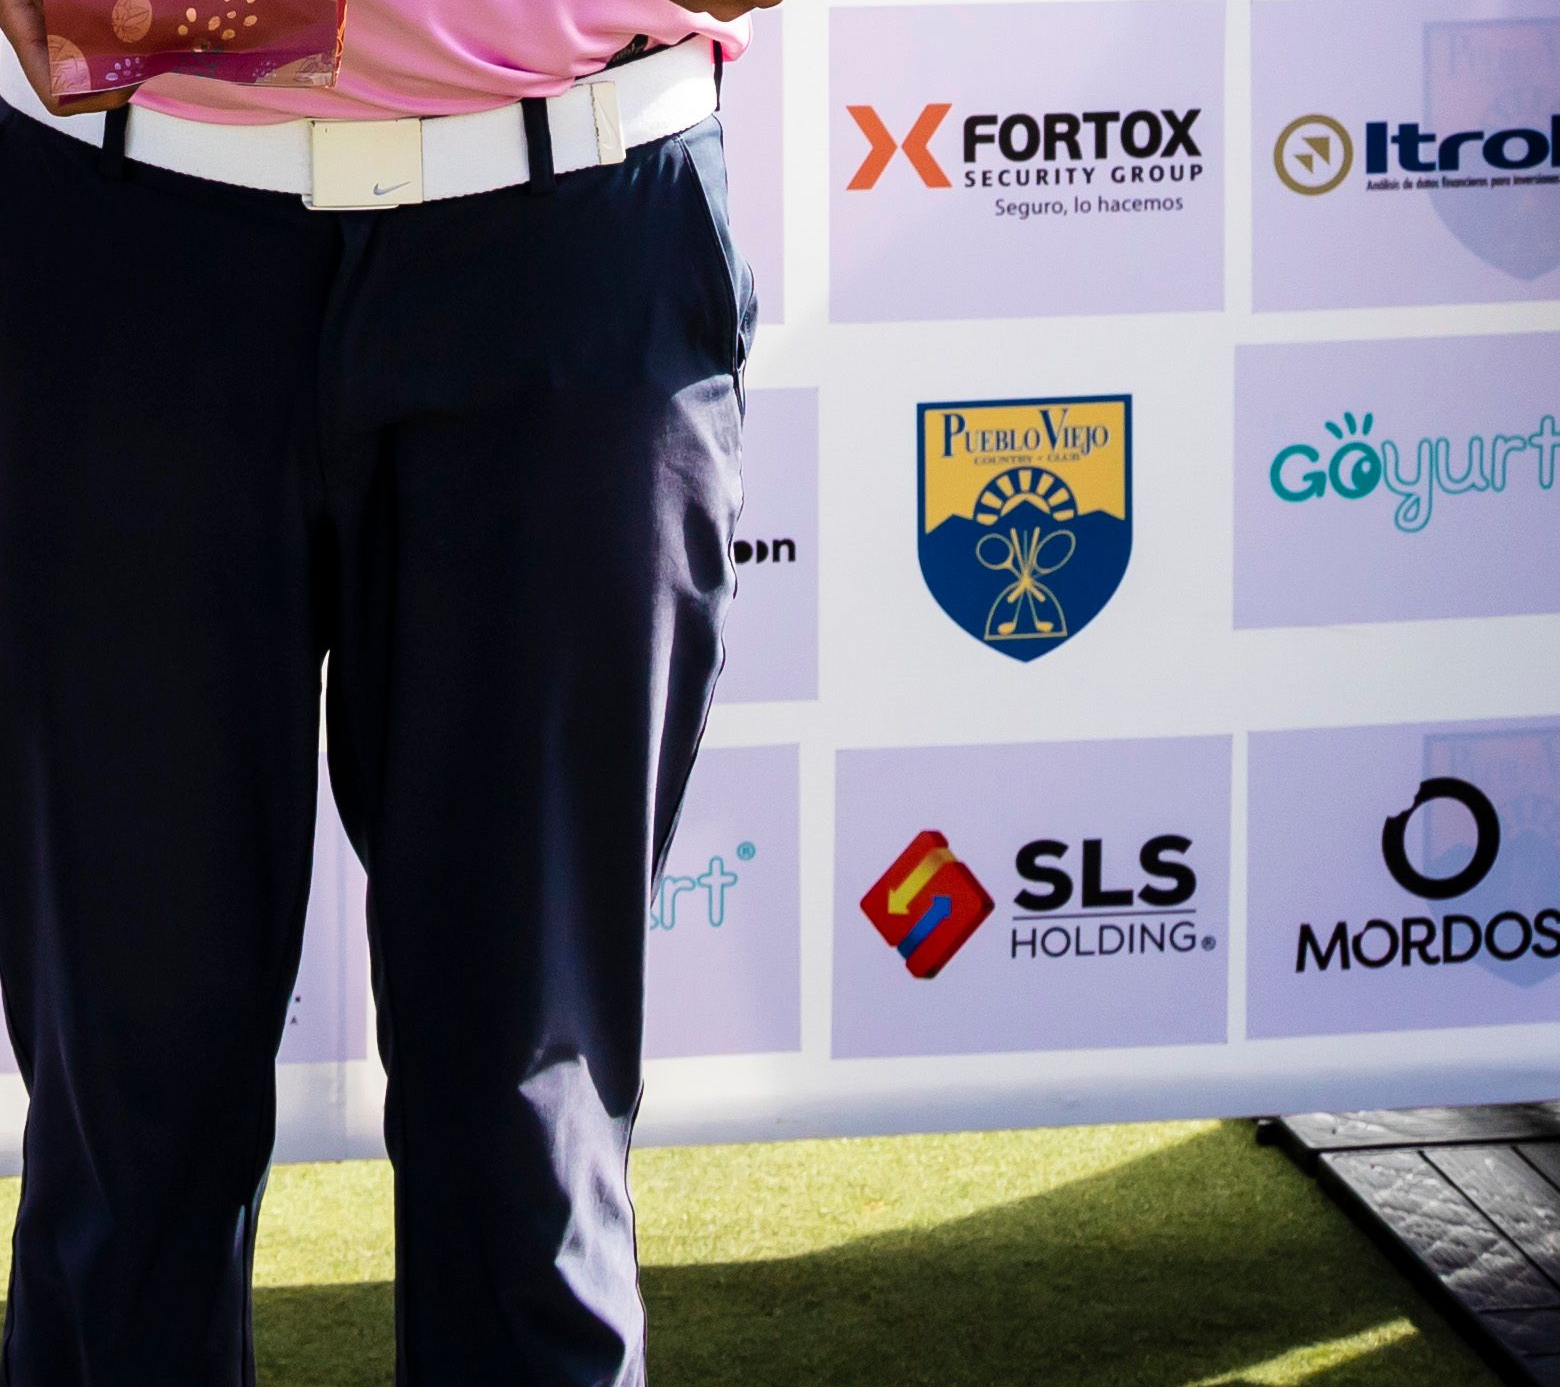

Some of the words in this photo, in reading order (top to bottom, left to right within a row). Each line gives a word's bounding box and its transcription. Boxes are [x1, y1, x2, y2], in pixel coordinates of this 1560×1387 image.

[963, 108, 1202, 162] FORTOX
[965, 166, 1099, 188] SECURITY
[1111, 162, 1203, 184] GROUP
[1403, 179, 1413, 189] de
[995, 196, 1067, 221] Seguro,
[1074, 194, 1090, 216] lo
[1098, 194, 1184, 214] hacemos
[942, 411, 1039, 458] PUEBLO
[1038, 408, 1110, 457] VIEJO
[1012, 835, 1195, 911] SLS
[1011, 921, 1195, 959] HOLDING
